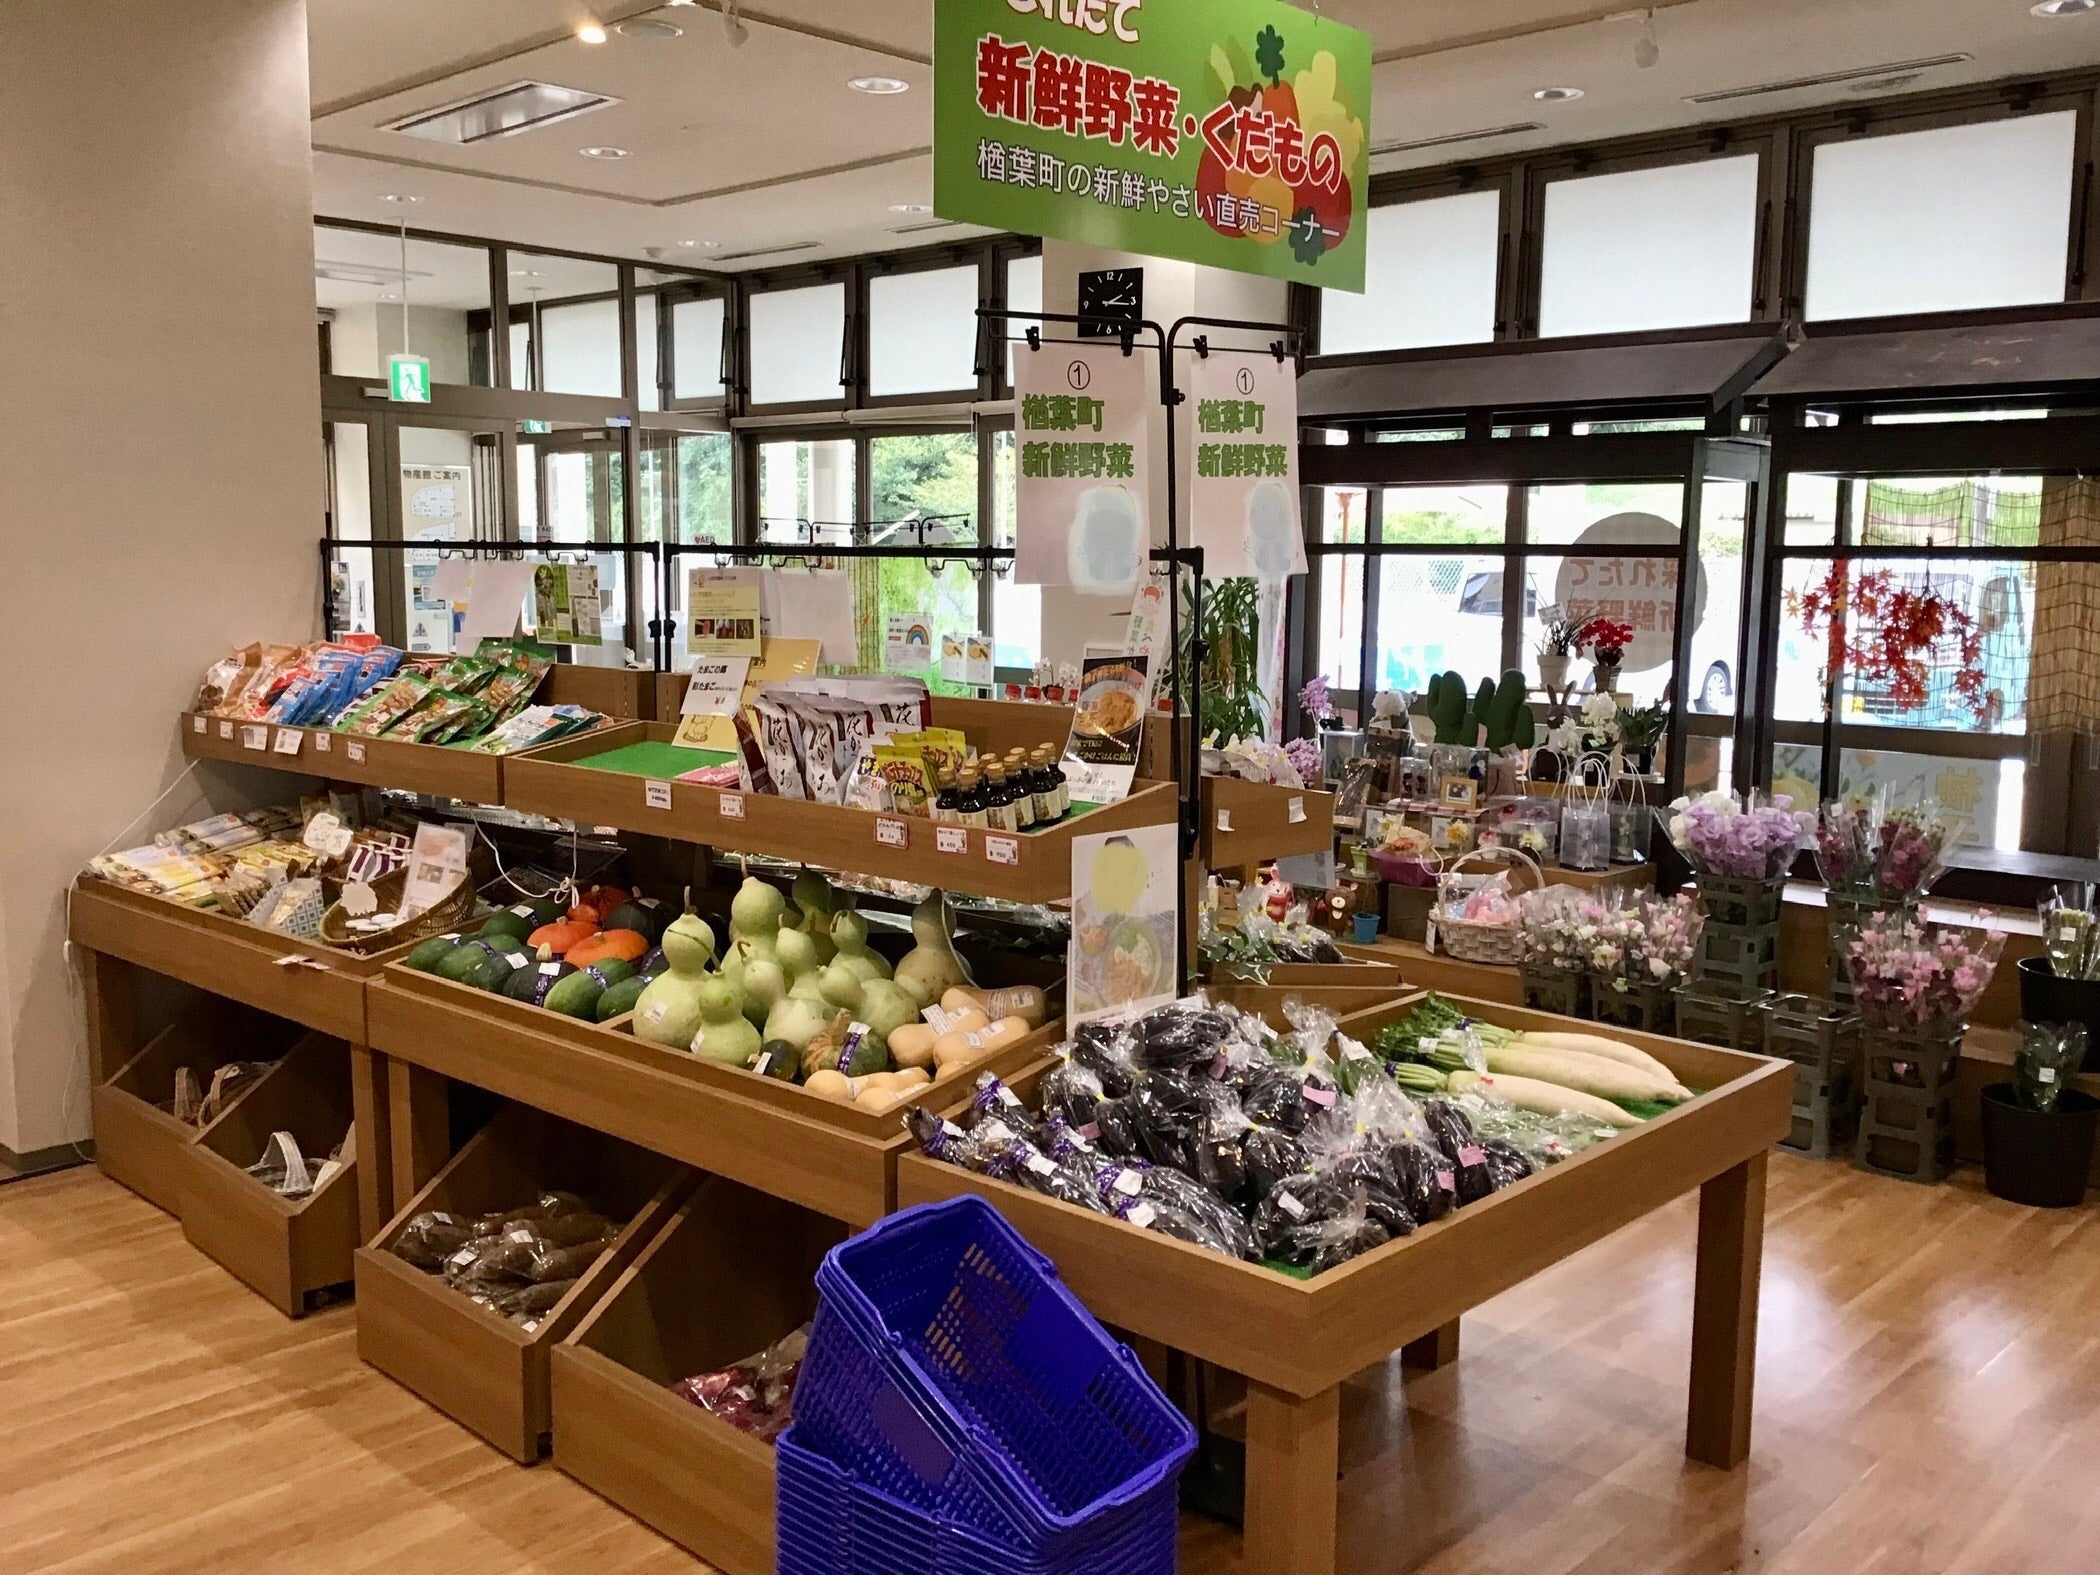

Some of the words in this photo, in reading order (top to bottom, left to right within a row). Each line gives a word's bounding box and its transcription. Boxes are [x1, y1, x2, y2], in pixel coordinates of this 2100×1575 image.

[1007, 0, 1140, 43] れたて
[976, 32, 1343, 194] 新鮮野菜・くだもの
[976, 138, 1340, 243] 楢葉町の新鮮やさい直売コーナー
[1106, 271, 1114, 281] 12
[1083, 300, 1089, 310] 9
[1130, 296, 1137, 306] 3
[1106, 325, 1112, 335] 6
[1021, 393, 1105, 432] 楢葉町
[1197, 398, 1266, 434] 楢葉町
[1021, 441, 1135, 479] 新鮮野菜
[1197, 443, 1289, 479] 新鮮野菜
